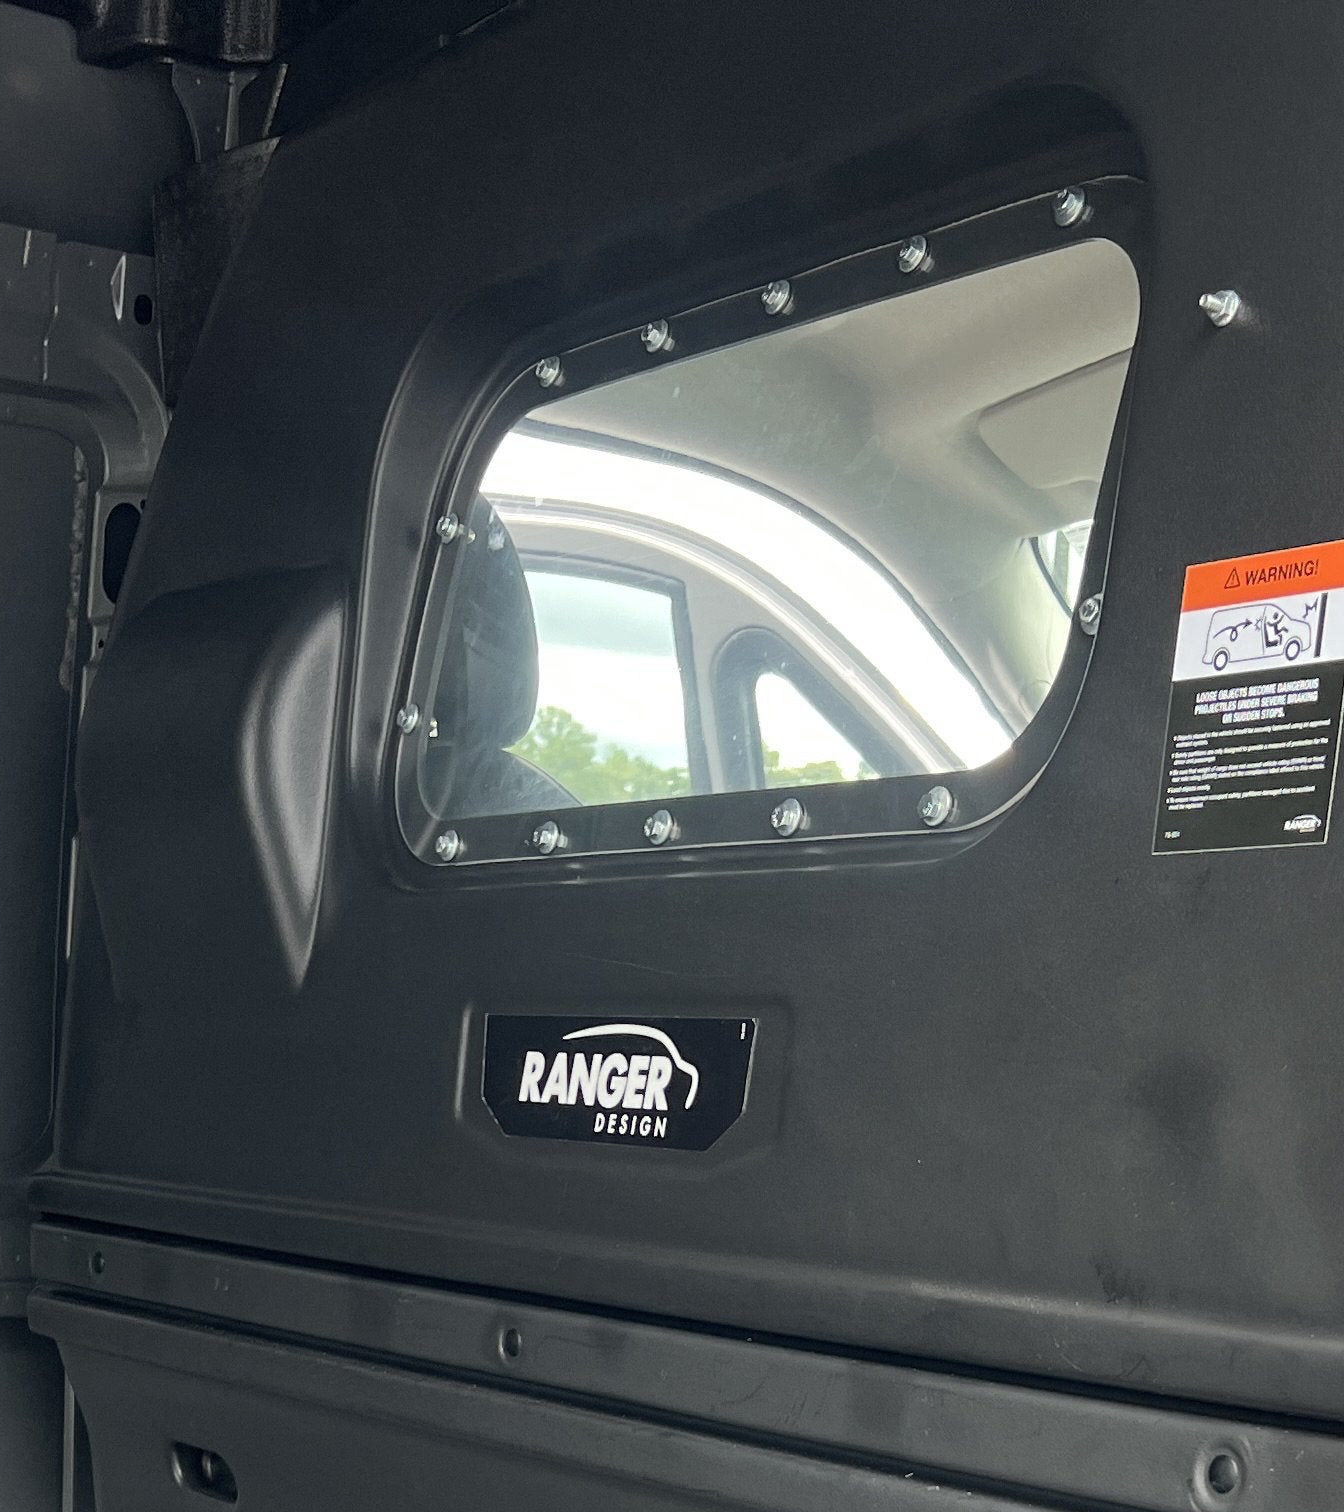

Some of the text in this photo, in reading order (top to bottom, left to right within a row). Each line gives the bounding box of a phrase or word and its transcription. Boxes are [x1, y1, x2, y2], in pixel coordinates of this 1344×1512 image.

[1245, 559, 1319, 586] WARNING!
[518, 1050, 673, 1111] RANGER
[593, 1112, 668, 1138] DESIGN
